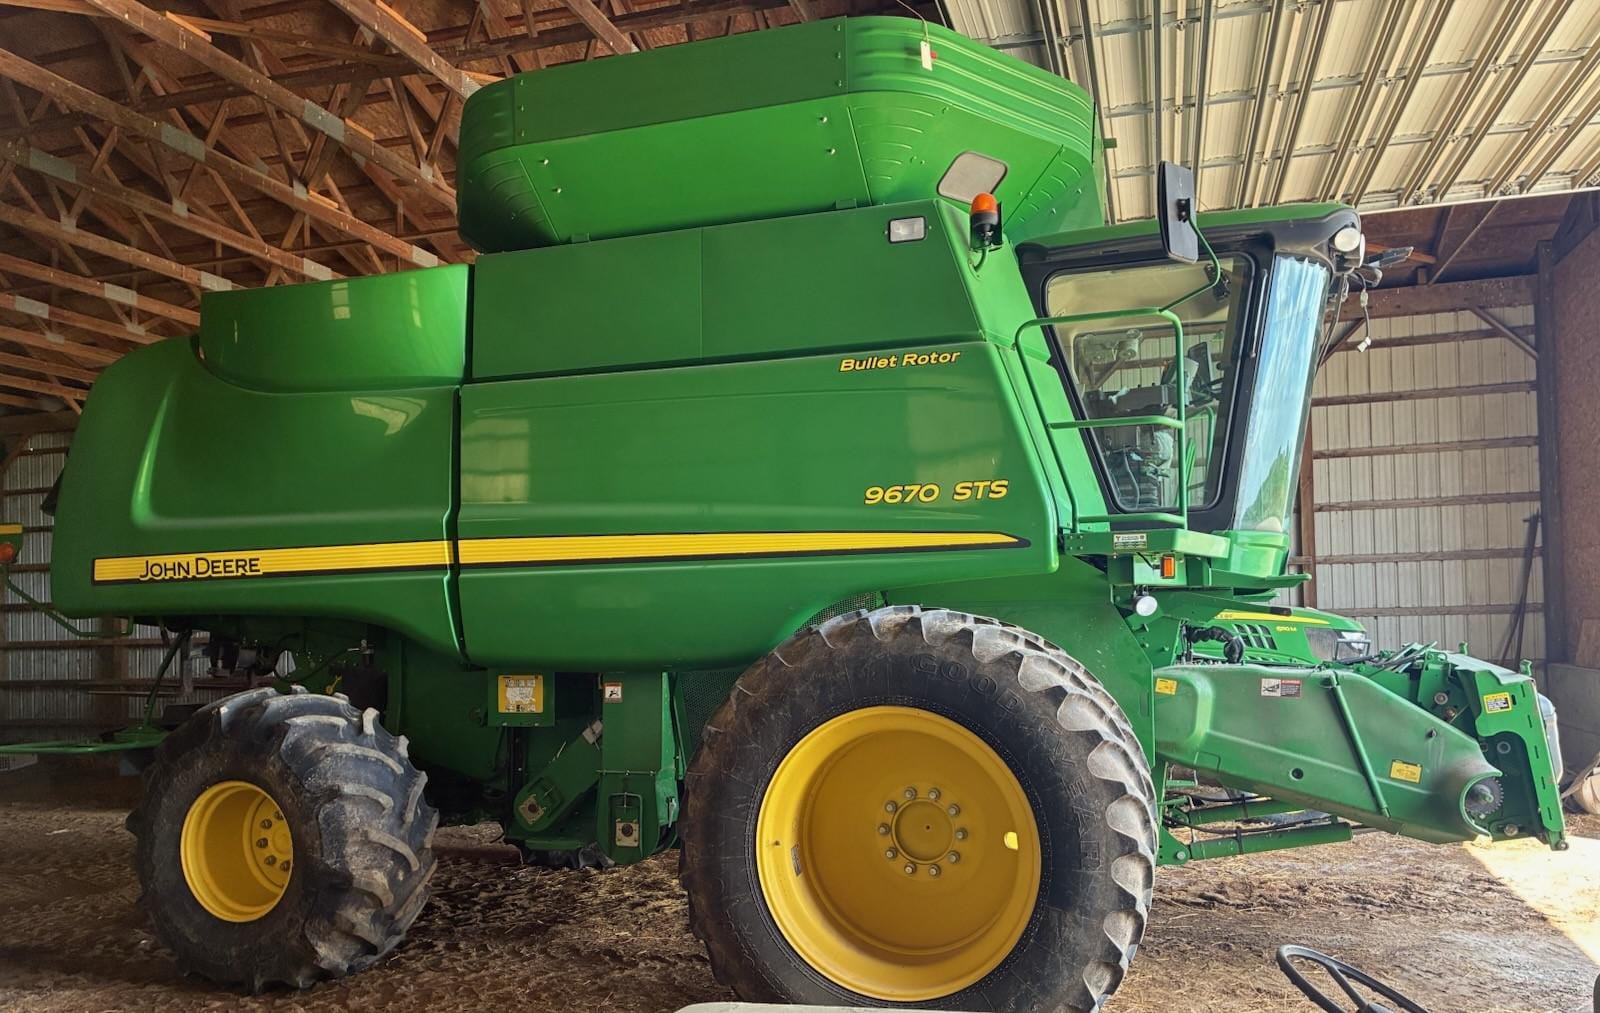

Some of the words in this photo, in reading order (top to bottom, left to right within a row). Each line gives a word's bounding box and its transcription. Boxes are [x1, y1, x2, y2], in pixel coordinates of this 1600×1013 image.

[839, 355, 897, 372] Bullet
[902, 351, 960, 367] Rotor
[864, 483, 940, 505] 9670
[953, 479, 1009, 501] STS
